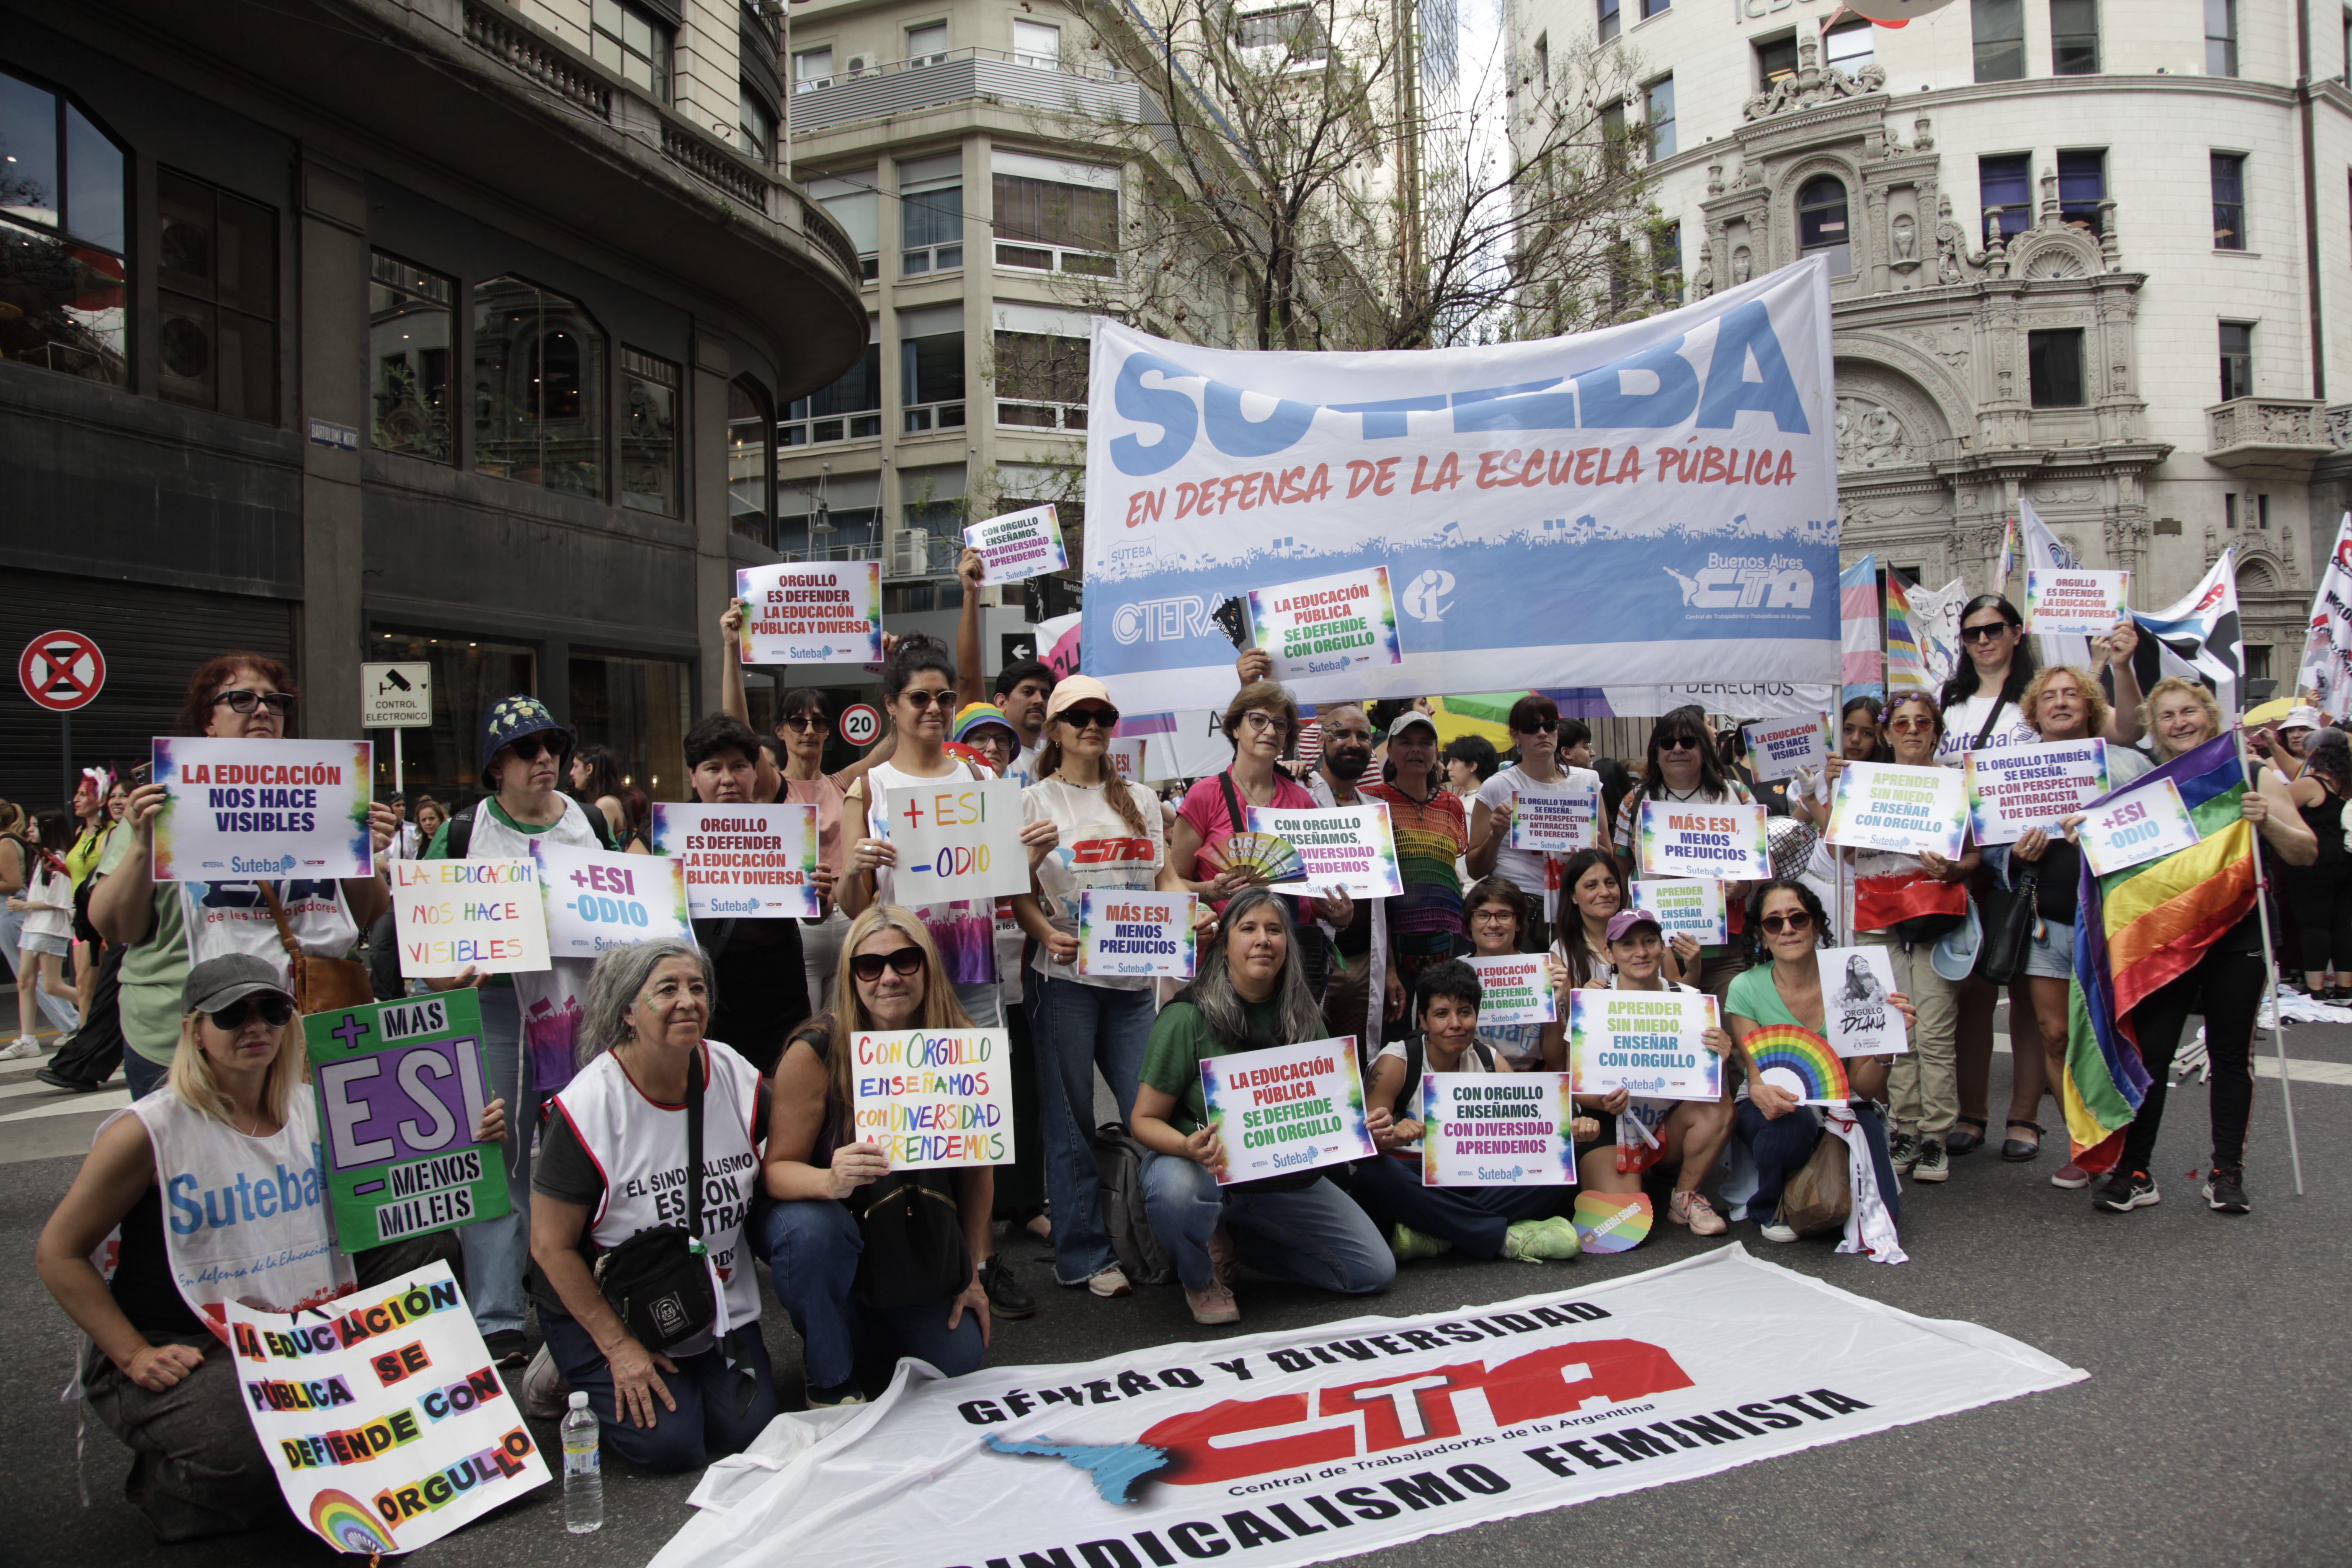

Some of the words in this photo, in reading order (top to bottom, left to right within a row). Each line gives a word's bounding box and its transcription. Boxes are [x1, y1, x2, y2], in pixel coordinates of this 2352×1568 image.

[343, 431, 357, 446] MITRE
[1126, 487, 1166, 528] EN
[1175, 463, 1334, 520] DEFENSA
[1346, 456, 1402, 499] DE
[1411, 451, 1464, 494] LA
[1476, 446, 1645, 489] ESCUELA
[1656, 436, 1797, 486] PÚBLICA
[982, 524, 998, 537] CON
[1001, 517, 1038, 534] ORGULLO
[980, 545, 998, 559] CON
[999, 536, 1049, 557] DIVERSIDAD
[985, 530, 1039, 547] ENSEÑAMOS,
[990, 547, 1046, 567] APRENDEMOS
[1112, 546, 1152, 562] SUTEBA
[1708, 553, 1764, 568] Buenos
[1768, 553, 1803, 569] Aires
[779, 575, 837, 587] ORGULLO
[1691, 567, 1813, 608] CTA
[768, 591, 783, 603] ES
[786, 590, 849, 602] DEFENDER
[1274, 599, 1292, 613] LA
[1293, 584, 1369, 609] EDUCACIÓN
[763, 606, 781, 619] LA
[782, 603, 854, 618] EDUCACIÓN
[1295, 604, 1352, 624] PÚBLICA
[751, 620, 805, 634] PÚBLICA
[806, 621, 815, 634] Y
[818, 621, 870, 633] DIVERSA
[1284, 628, 1301, 642] SE
[1303, 617, 1367, 639] DEFIENDE
[1284, 642, 1312, 658] CON
[1314, 632, 1375, 653] ORGULLO
[366, 712, 427, 721] ELECTRONICO
[850, 717, 871, 732] 20
[1976, 761, 1989, 771] EL
[1991, 756, 2041, 770] ORGULLO
[2043, 749, 2091, 764] TAMBIÉN
[183, 765, 210, 784] LA
[216, 762, 340, 785] EDUCACIÓN
[1873, 773, 1939, 789] APRENDER
[2004, 771, 2018, 781] SE
[2020, 765, 2066, 779] ENSEÑA:
[1870, 787, 1890, 801] SIN
[1893, 789, 1935, 805] MIEDO,
[1978, 786, 1996, 797] ESI
[1998, 783, 2021, 794] CON
[2023, 776, 2098, 792] PERSPECTIVA
[210, 789, 255, 808] NOS
[260, 789, 316, 808] HACE
[935, 792, 984, 826] ESI
[1871, 802, 1929, 817] ENSEÑAR
[2000, 790, 2078, 807] ANTIRRACISTA
[216, 812, 315, 832] VISIBLES
[1669, 813, 1706, 830] MÁS
[1709, 818, 1739, 834] ESI,
[1856, 814, 1882, 826] CON
[1883, 817, 1942, 833] ORGULLO
[2000, 810, 2006, 820] Y
[2009, 808, 2023, 819] DE
[2103, 801, 2146, 828] +ESI
[1680, 833, 1730, 846] MENOS
[2105, 820, 2159, 848] -ODIO
[936, 844, 990, 877] ODIO
[1072, 838, 1154, 863] CTA
[1665, 845, 1746, 861] PREJUICIOS
[398, 864, 431, 887] LA
[441, 860, 531, 884] EDUCACIÓN
[207, 913, 224, 923] de
[230, 910, 249, 920] les
[253, 900, 337, 920] traajadores
[412, 902, 454, 924] NOS
[465, 903, 519, 921] HACE
[1106, 903, 1141, 921] MÁS
[1144, 904, 1173, 925] ESI,
[1116, 925, 1161, 938] MENOS
[408, 939, 523, 964] VISIBLES
[1100, 940, 1176, 954] PREJUICIOS
[1608, 1002, 1681, 1015] APRENDER
[1845, 1007, 1883, 1019] ORGULLO
[1607, 1018, 1632, 1034] SIN
[1634, 1019, 1682, 1036] MIEDO,
[1841, 1011, 1885, 1034] DIANA
[1614, 1033, 1677, 1050] ENSEÑAR
[1599, 1052, 1627, 1066] CON
[1631, 1053, 1695, 1068] ORGULLO
[1230, 1072, 1249, 1090] LA
[1250, 1056, 1334, 1086] EDUCACIÓN
[861, 1072, 989, 1097] ENSEÑAMOS
[1253, 1081, 1316, 1106] PÚBLICA
[1453, 1087, 1481, 1100] CON
[1485, 1086, 1543, 1100] ORGULLO
[319, 1037, 484, 1170] ESI
[1243, 1110, 1262, 1128] SE
[1264, 1097, 1333, 1124] DEFIENDE
[1457, 1100, 1542, 1120] ENSEÑAMOS,
[890, 1103, 1000, 1132] DIVERSIDAD
[1244, 1128, 1275, 1148] CON
[1277, 1116, 1341, 1142] ORGULLO
[1444, 1124, 1472, 1138] CON
[1476, 1122, 1553, 1136] DIVERSIDAD
[1456, 1140, 1546, 1154] APRENDEMOS
[392, 1153, 480, 1197] MENOS
[168, 1164, 322, 1235] Suteba
[627, 1179, 647, 1198] EL
[379, 1190, 470, 1236] MILEIS
[655, 1189, 685, 1220] ES
[1618, 1202, 1642, 1221] SOMOS
[1594, 1215, 1622, 1237] FUERTES
[198, 1266, 247, 1284] defensa
[251, 1260, 264, 1274] de
[266, 1256, 277, 1269] la
[232, 1323, 265, 1358] LA
[263, 1275, 457, 1357] EDUCACIÓN
[663, 1317, 680, 1327] TROWN
[1267, 1300, 1614, 1372] DIVERSIDAD
[248, 1378, 354, 1411] PÚBLICA
[372, 1344, 428, 1385] SE
[1210, 1358, 1253, 1380] Y
[282, 1411, 418, 1468] DEFIENDE
[424, 1366, 502, 1418] CON
[1136, 1335, 1701, 1496] CTA
[1522, 1388, 1875, 1480] FEMINISTA
[1229, 1473, 1312, 1496] Central
[1318, 1465, 1348, 1478] de
[1352, 1429, 1495, 1470] Trabajadorxs
[1501, 1428, 1528, 1439] de
[1531, 1421, 1554, 1432] la
[1558, 1400, 1656, 1430] Argentina
[378, 1431, 530, 1522] ORGULLO
